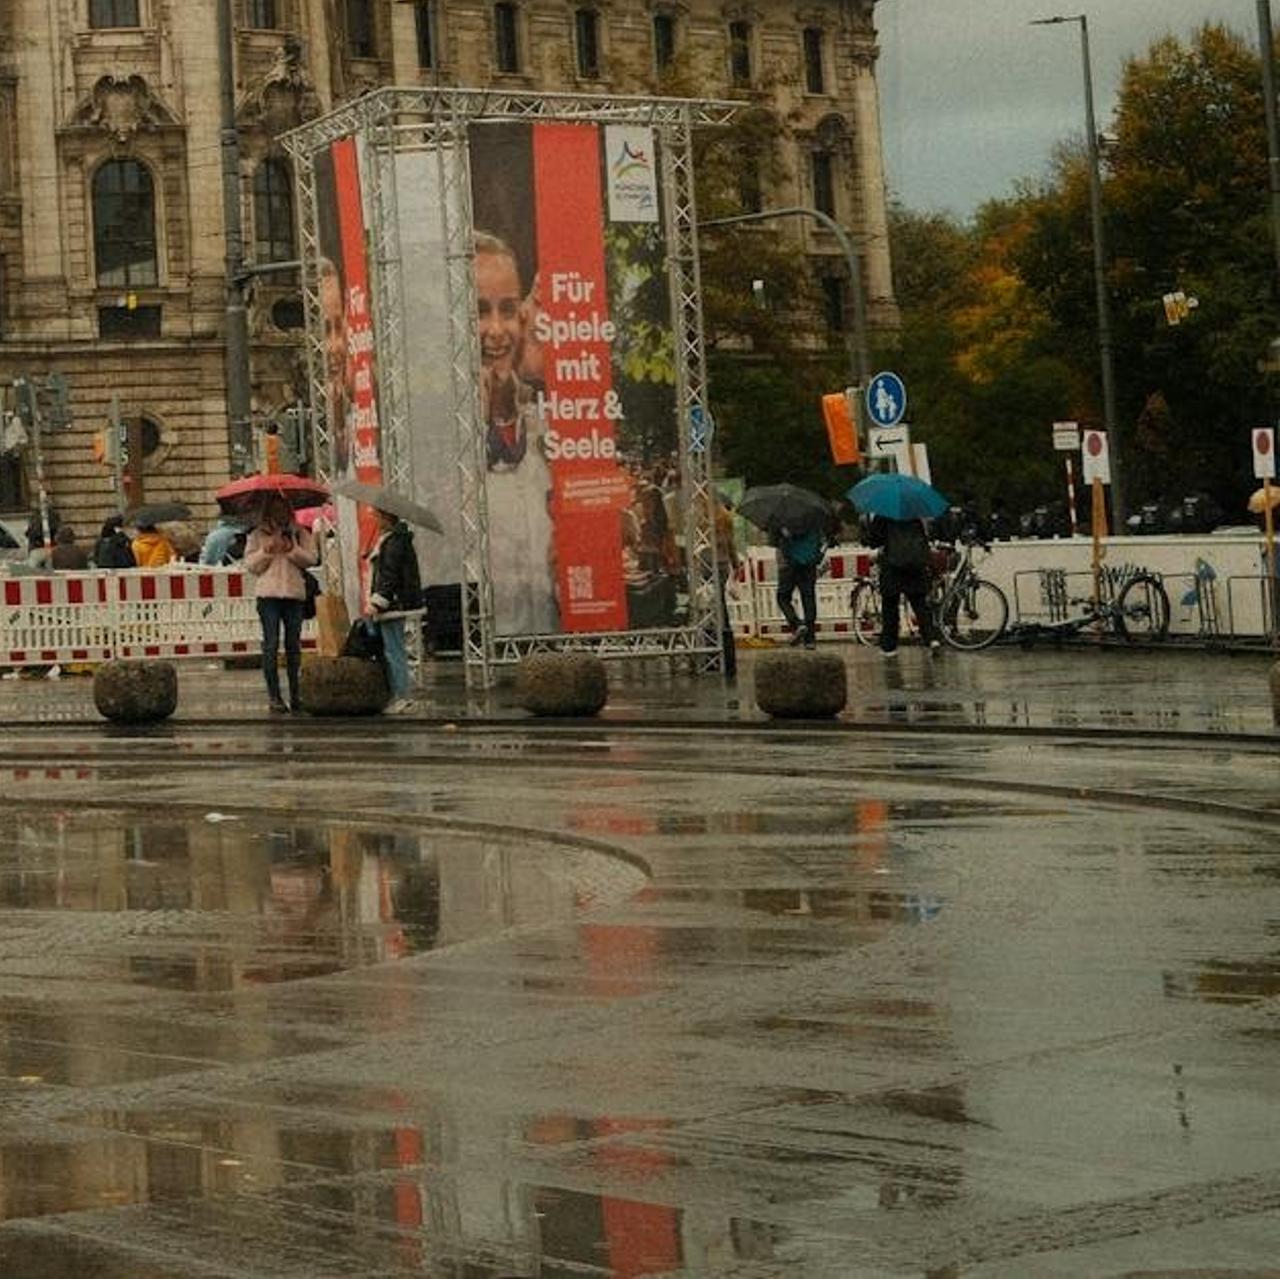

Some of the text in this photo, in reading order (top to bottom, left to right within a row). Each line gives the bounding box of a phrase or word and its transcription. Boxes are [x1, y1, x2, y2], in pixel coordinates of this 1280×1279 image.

[551, 272, 595, 303] Für
[535, 311, 617, 350] Spiele
[555, 350, 602, 382] mit
[537, 389, 625, 420] Herz &
[544, 427, 623, 461] Seele.
